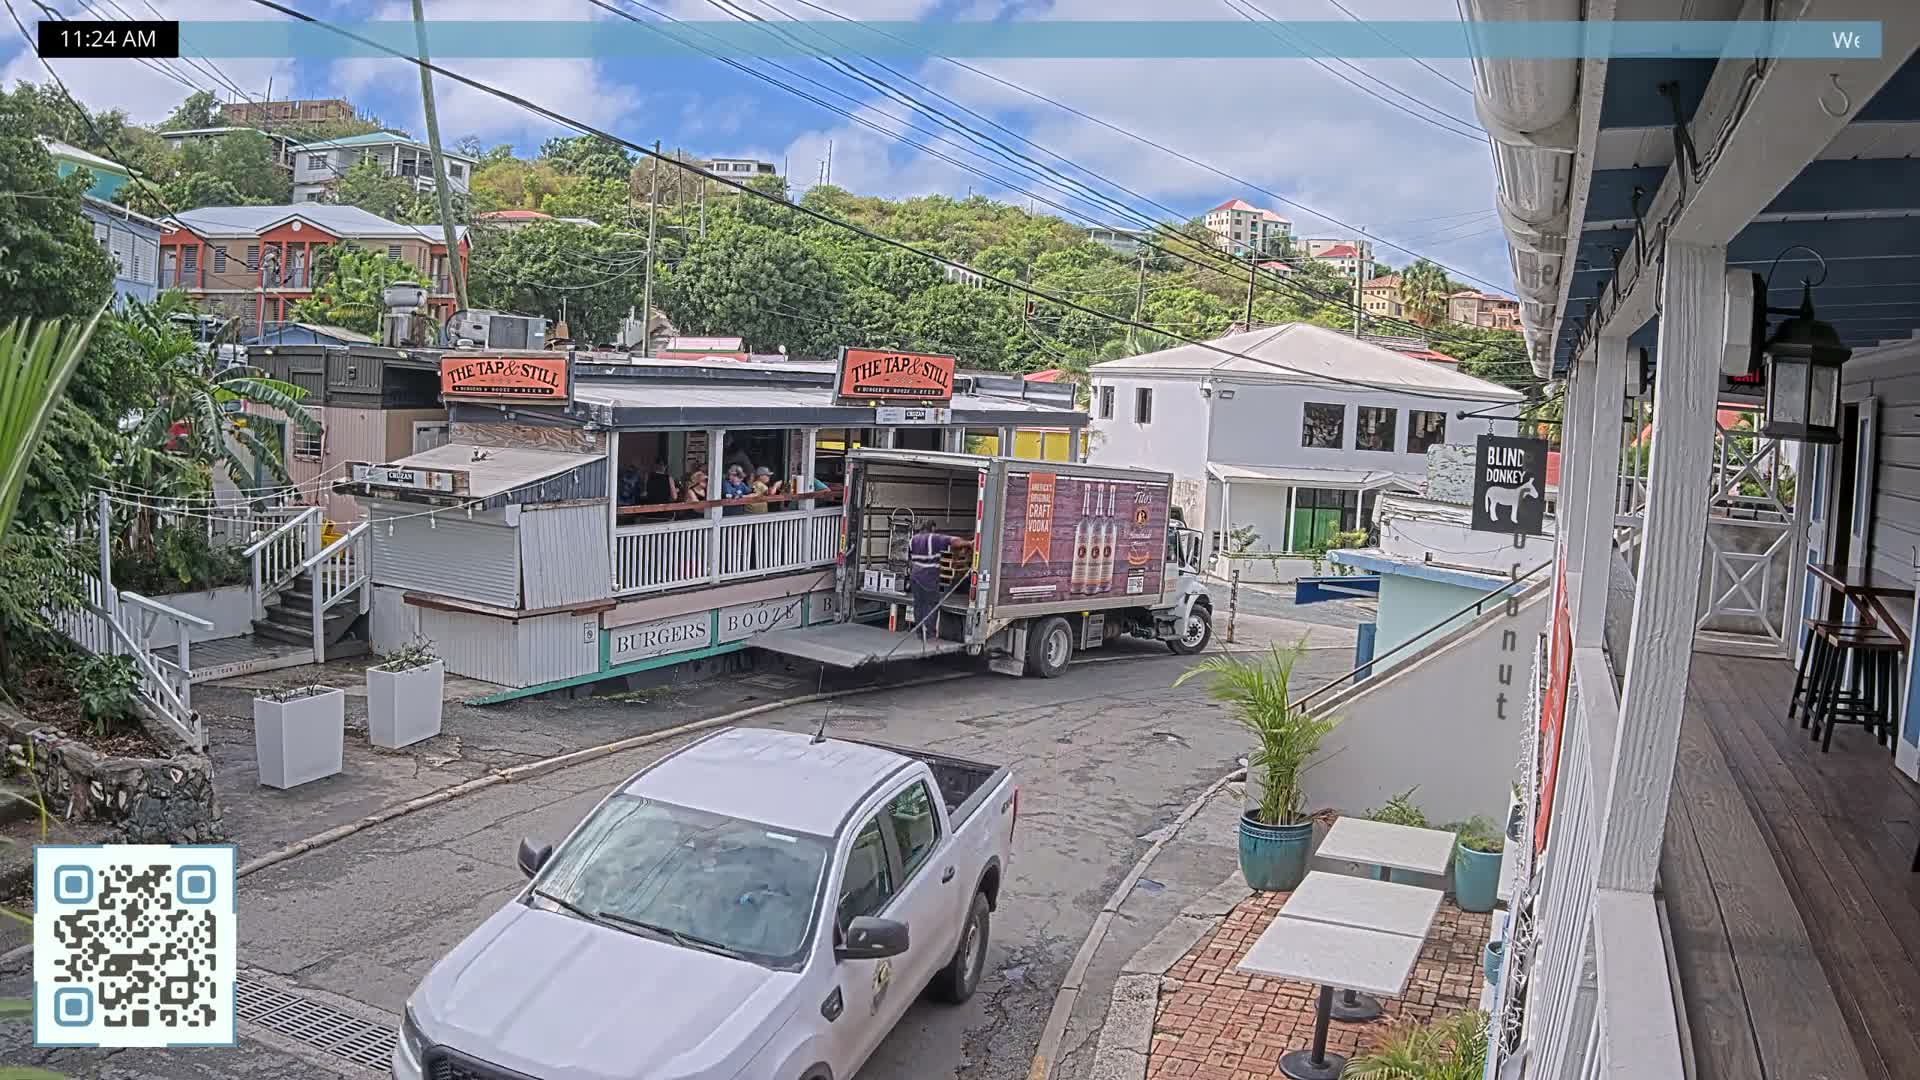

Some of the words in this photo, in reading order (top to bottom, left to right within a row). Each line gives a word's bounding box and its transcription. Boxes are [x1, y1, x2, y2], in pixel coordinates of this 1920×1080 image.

[447, 364, 476, 384] THE
[476, 361, 505, 376] TAP
[503, 360, 520, 376] &
[520, 363, 560, 388] STILL
[852, 359, 882, 384] THE
[884, 356, 910, 374] TAP
[907, 357, 921, 376] &
[922, 361, 949, 388] STILL
[1487, 446, 1525, 467] BLIND
[388, 472, 413, 480] CRUZAN
[1486, 468, 1526, 484] DONKEY
[1134, 491, 1153, 504] Tito's
[1029, 504, 1051, 518] CRAFT
[1028, 519, 1049, 533] VODKA
[727, 604, 794, 632] BOOZE
[616, 622, 706, 653] BURGERS
